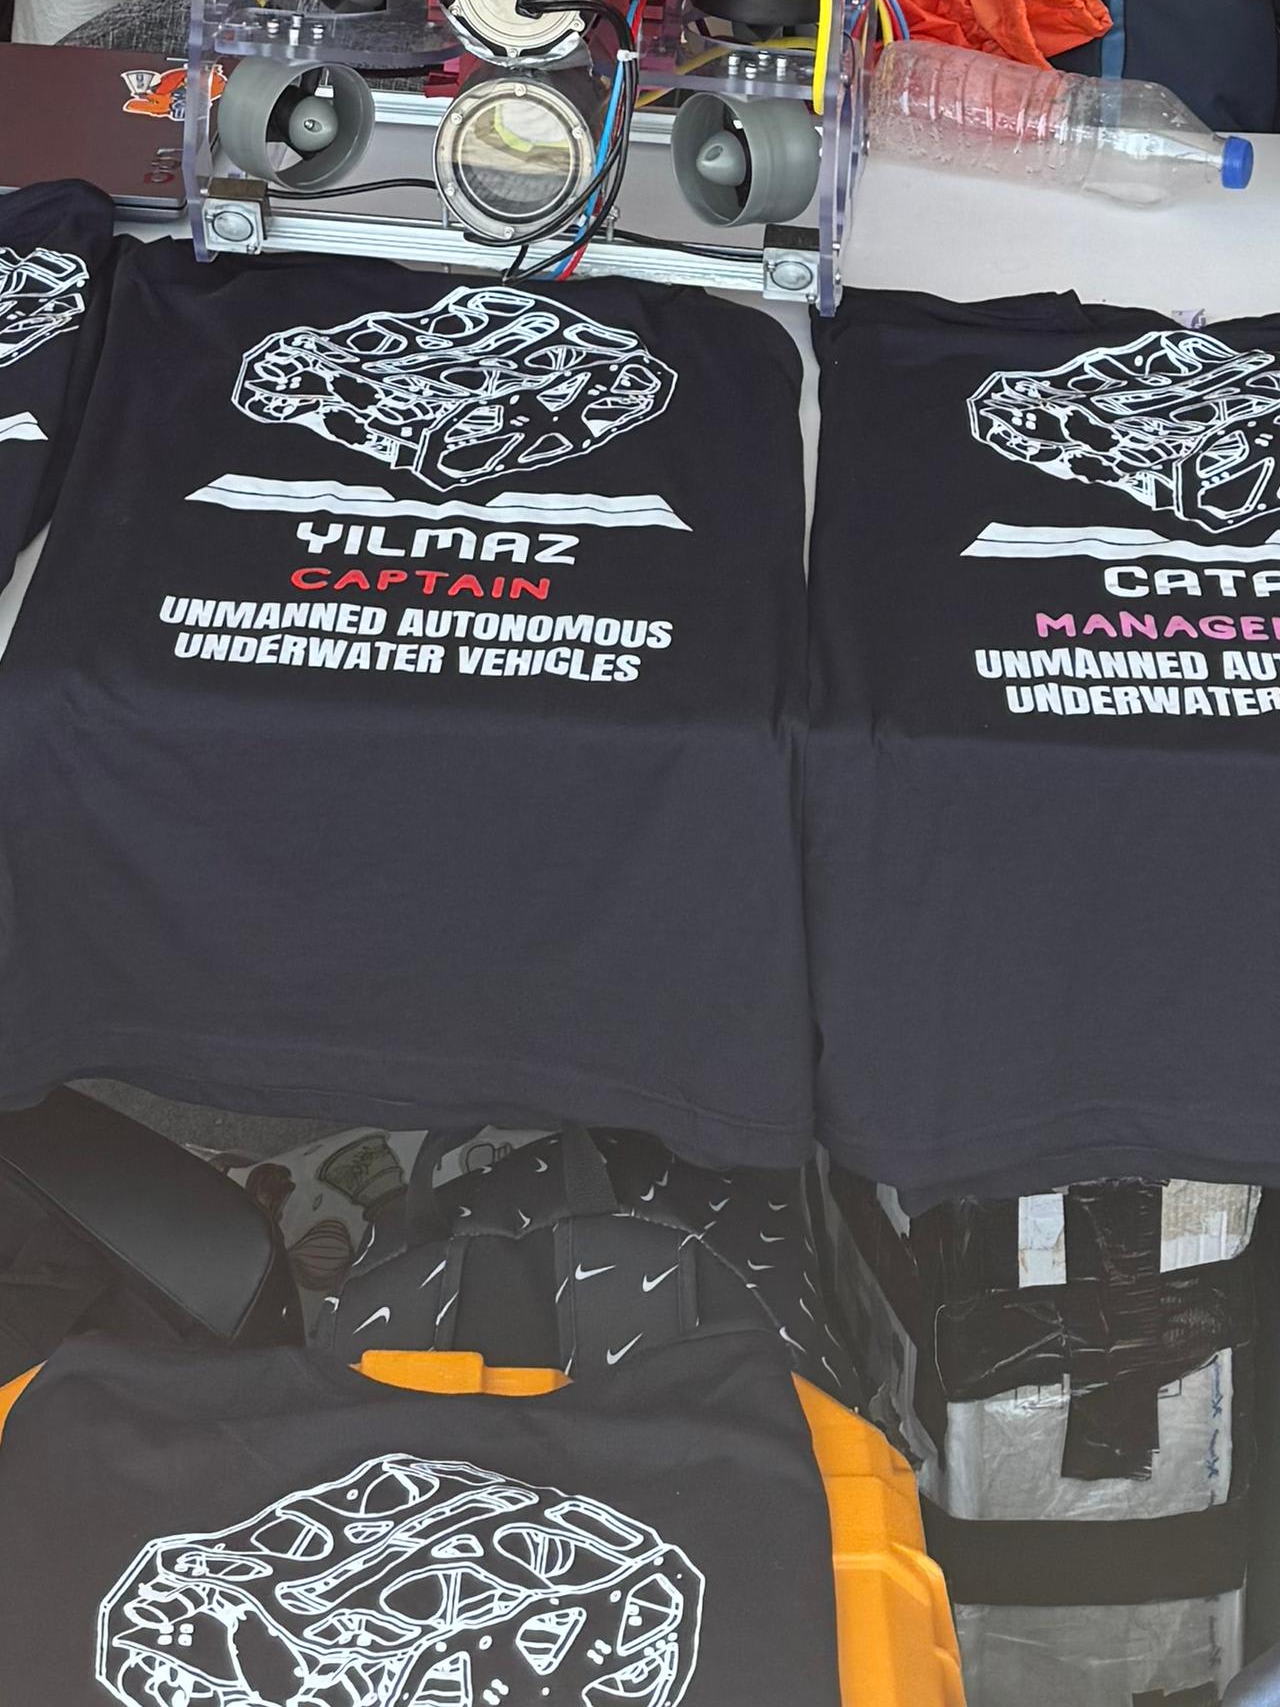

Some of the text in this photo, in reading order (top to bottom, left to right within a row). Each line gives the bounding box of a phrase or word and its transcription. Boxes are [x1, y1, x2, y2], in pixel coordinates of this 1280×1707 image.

[297, 522, 579, 564] YILMAZ
[291, 568, 551, 600] CAPTAIN
[159, 596, 673, 649] UNMANNED AUTONOMOUS
[174, 632, 640, 683] UNDERWATER VEHICLES
[975, 648, 1208, 681] UNMANNED
